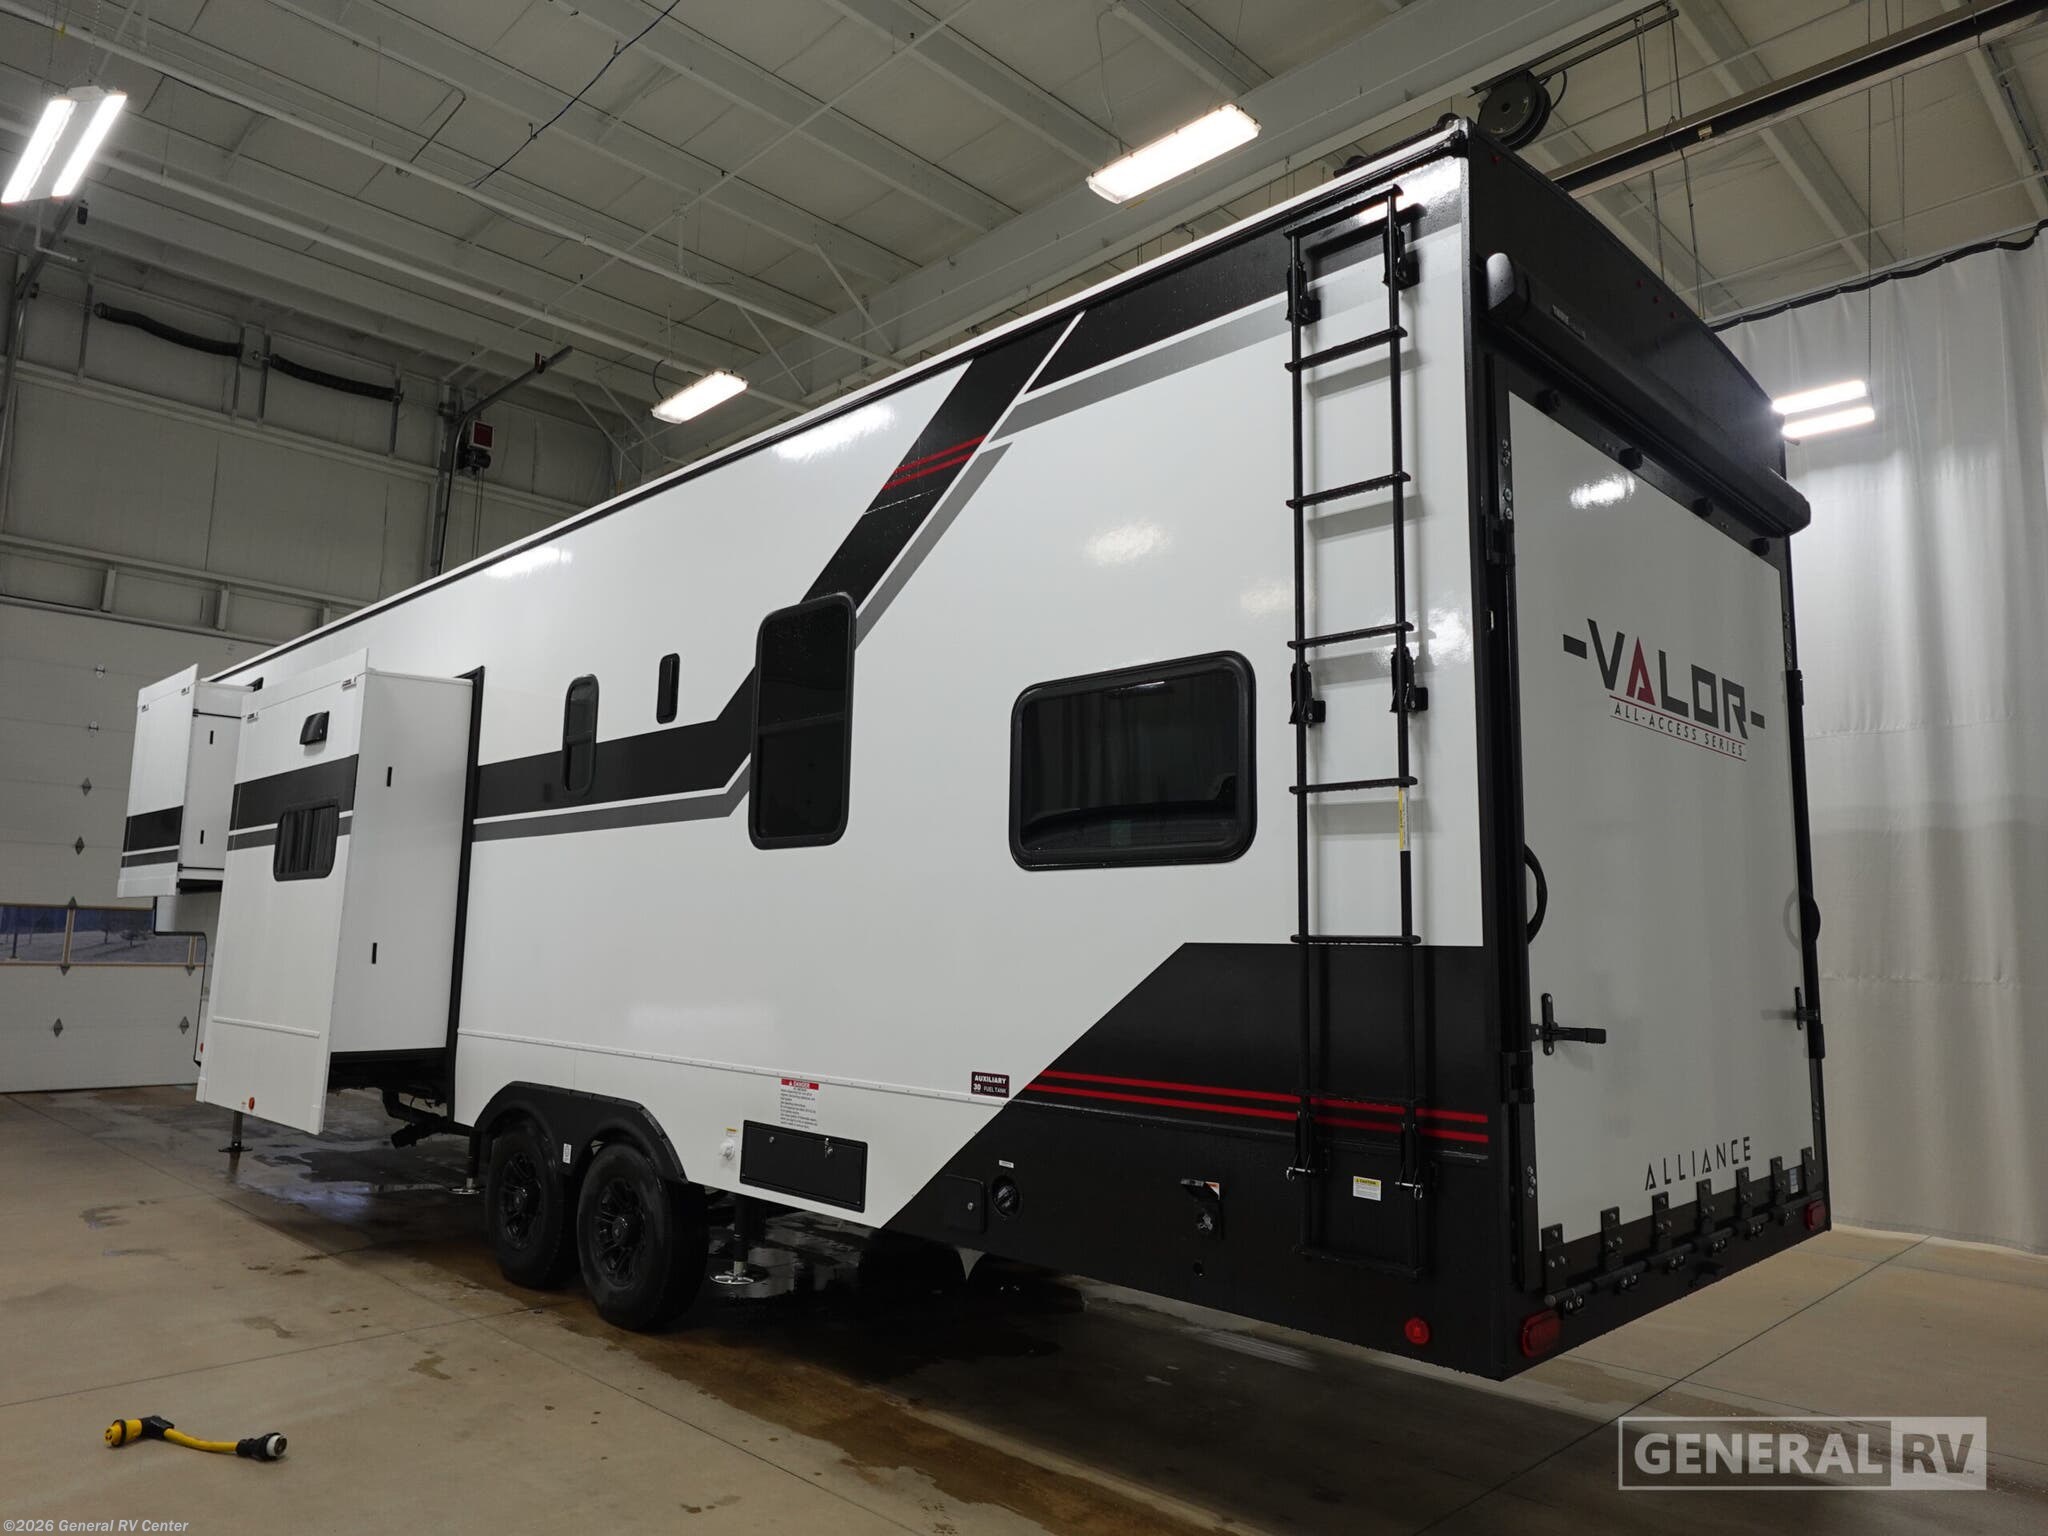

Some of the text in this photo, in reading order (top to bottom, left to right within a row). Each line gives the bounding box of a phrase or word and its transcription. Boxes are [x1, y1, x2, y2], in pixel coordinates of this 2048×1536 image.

[1614, 703, 1743, 757] ALL-ACCESS SERIES
[974, 1075, 1007, 1084] AUXILIARY
[1645, 1136, 1752, 1191] ALLIANCE
